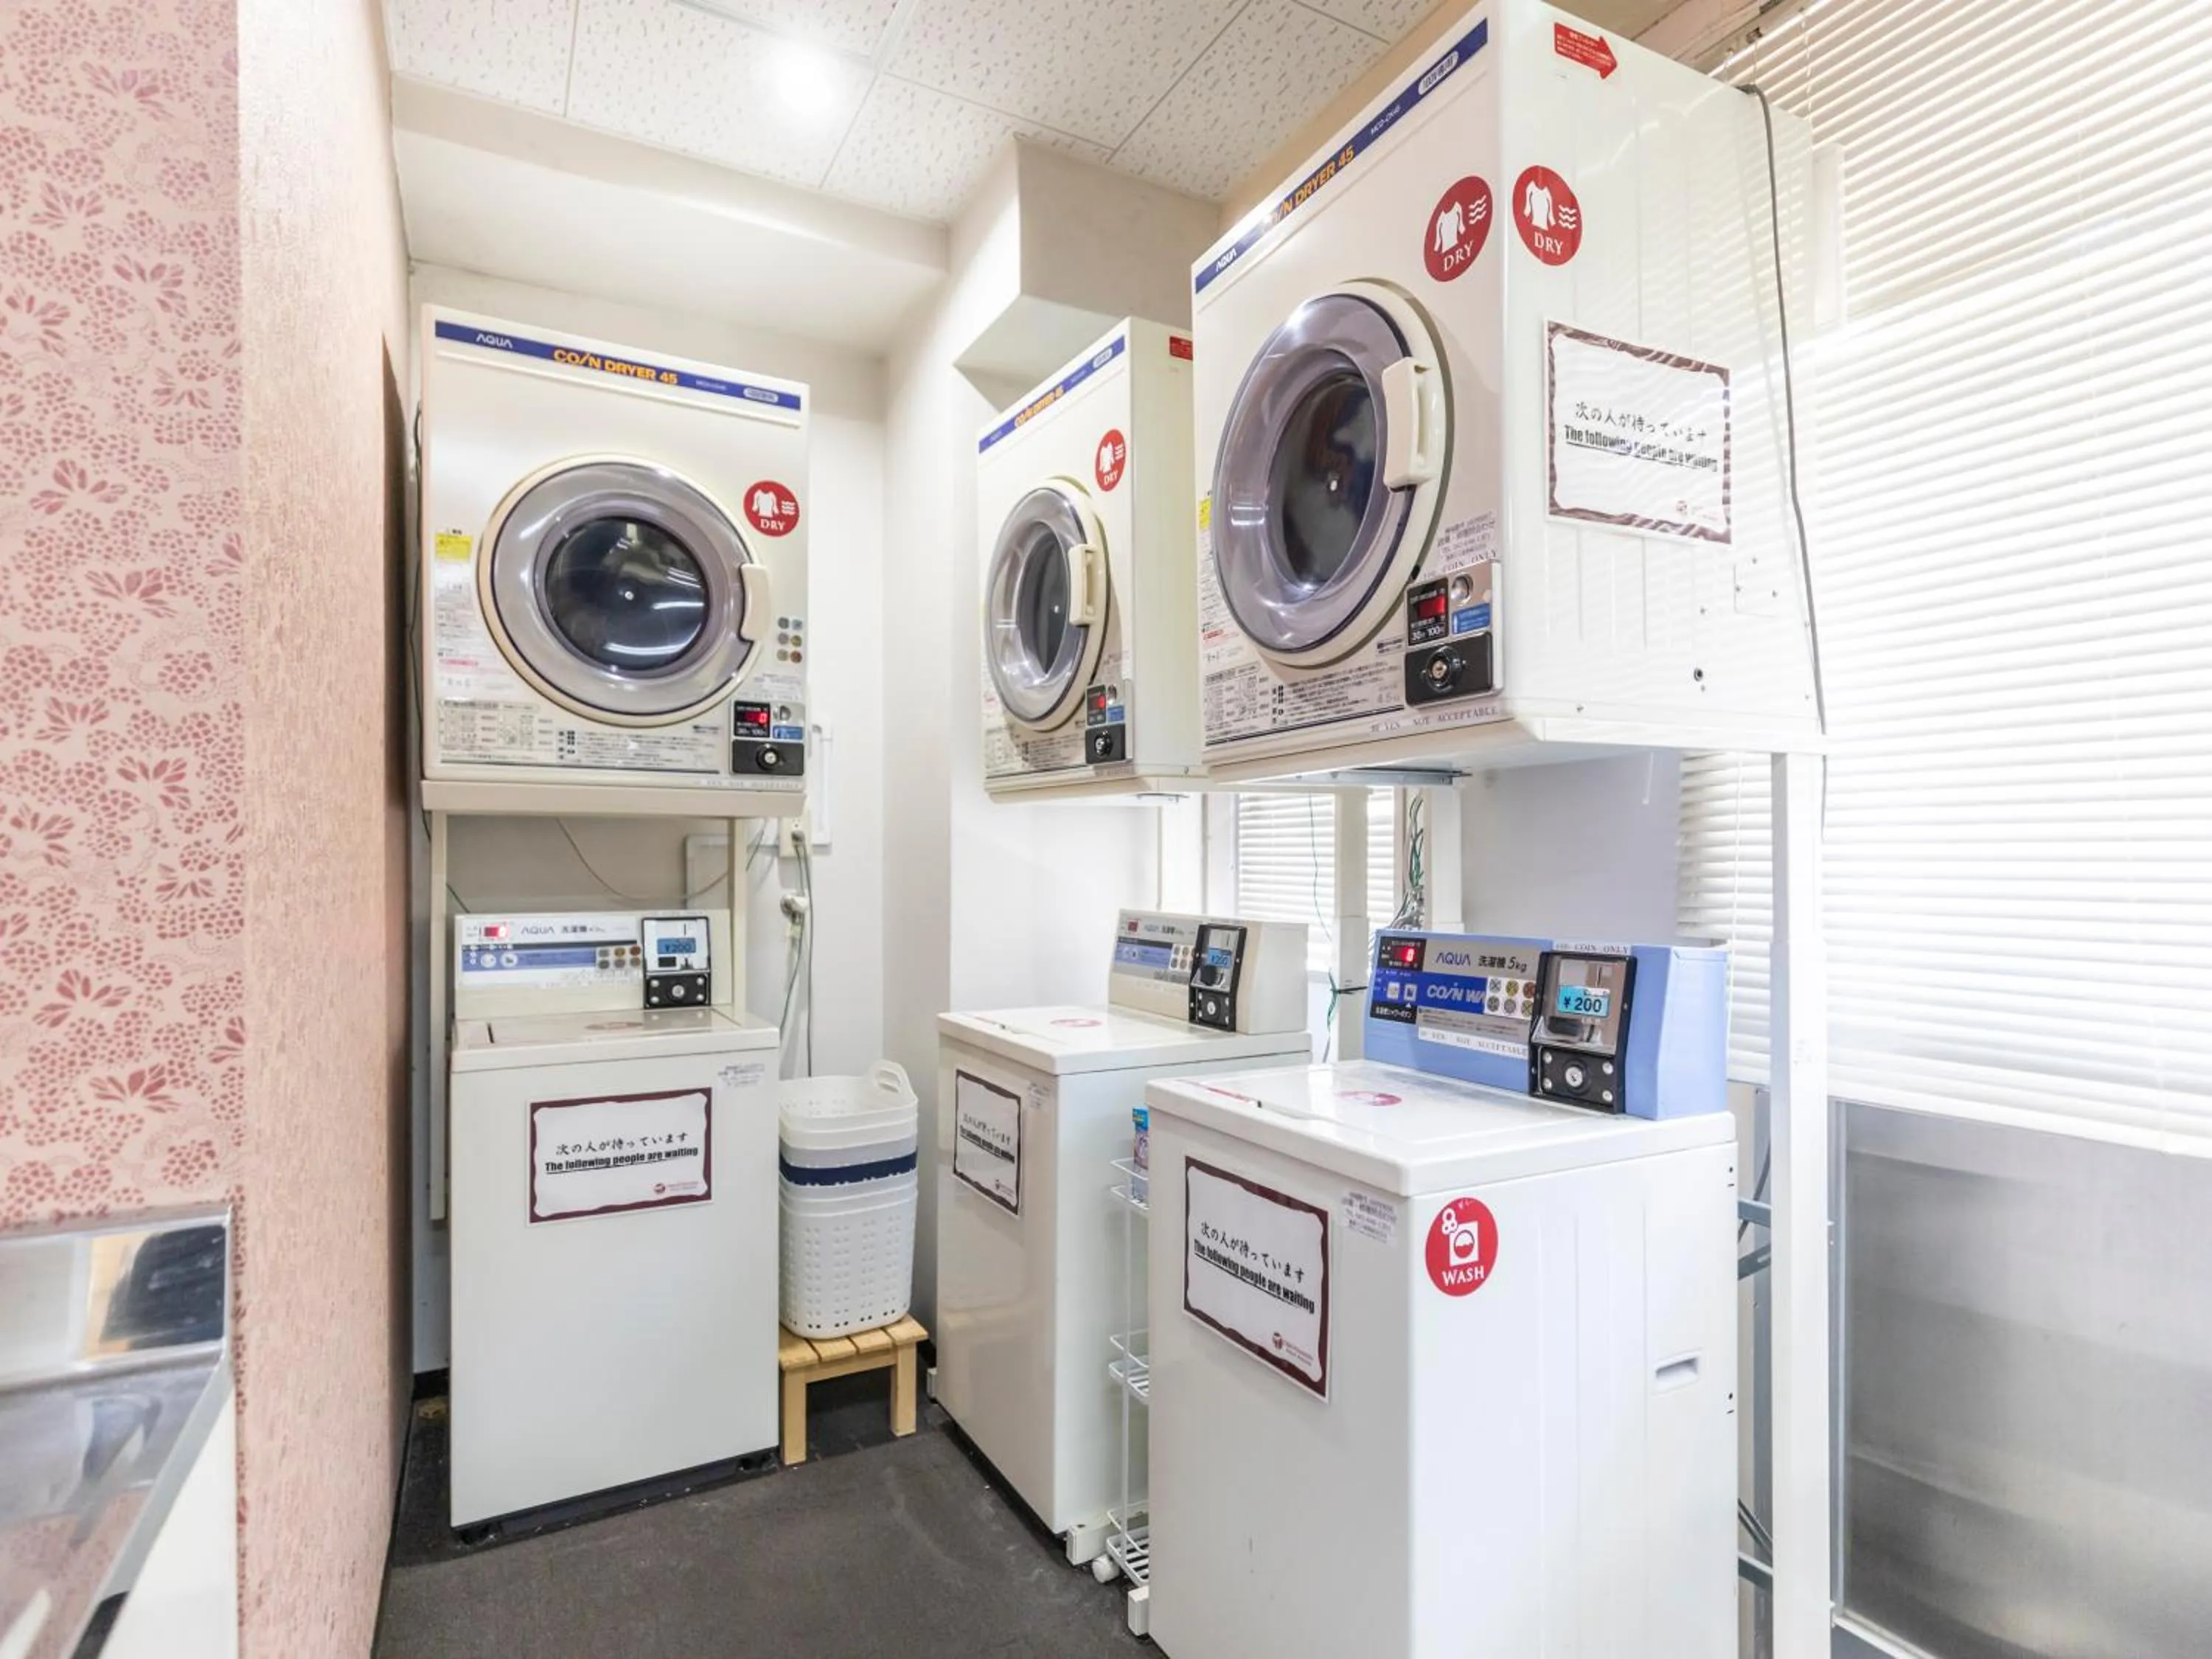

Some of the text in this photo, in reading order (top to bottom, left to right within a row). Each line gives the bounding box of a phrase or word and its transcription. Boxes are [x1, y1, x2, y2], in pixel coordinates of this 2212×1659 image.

[1295, 161, 1336, 205] DRYER
[1338, 145, 1354, 166] 45
[1443, 240, 1474, 271] DRY
[1534, 232, 1564, 255] DRY
[476, 333, 513, 349] AQUA
[605, 358, 656, 381] DRYER
[659, 371, 678, 385] 45
[1565, 425, 1584, 442] The
[1585, 429, 1632, 453] following
[760, 518, 786, 531] DRY
[1413, 717, 1430, 726] NOT
[1439, 706, 1498, 722] ACCEPTABLE
[521, 925, 554, 934] AQUA
[1436, 951, 1471, 966] AQUA
[555, 1132, 689, 1156] 次の人が待っています
[545, 1147, 698, 1172] The following people are waiting
[1200, 1221, 1304, 1283] 次の人が待っています
[1194, 1238, 1315, 1315] The following people are waiting
[1441, 1266, 1485, 1287] WASH
